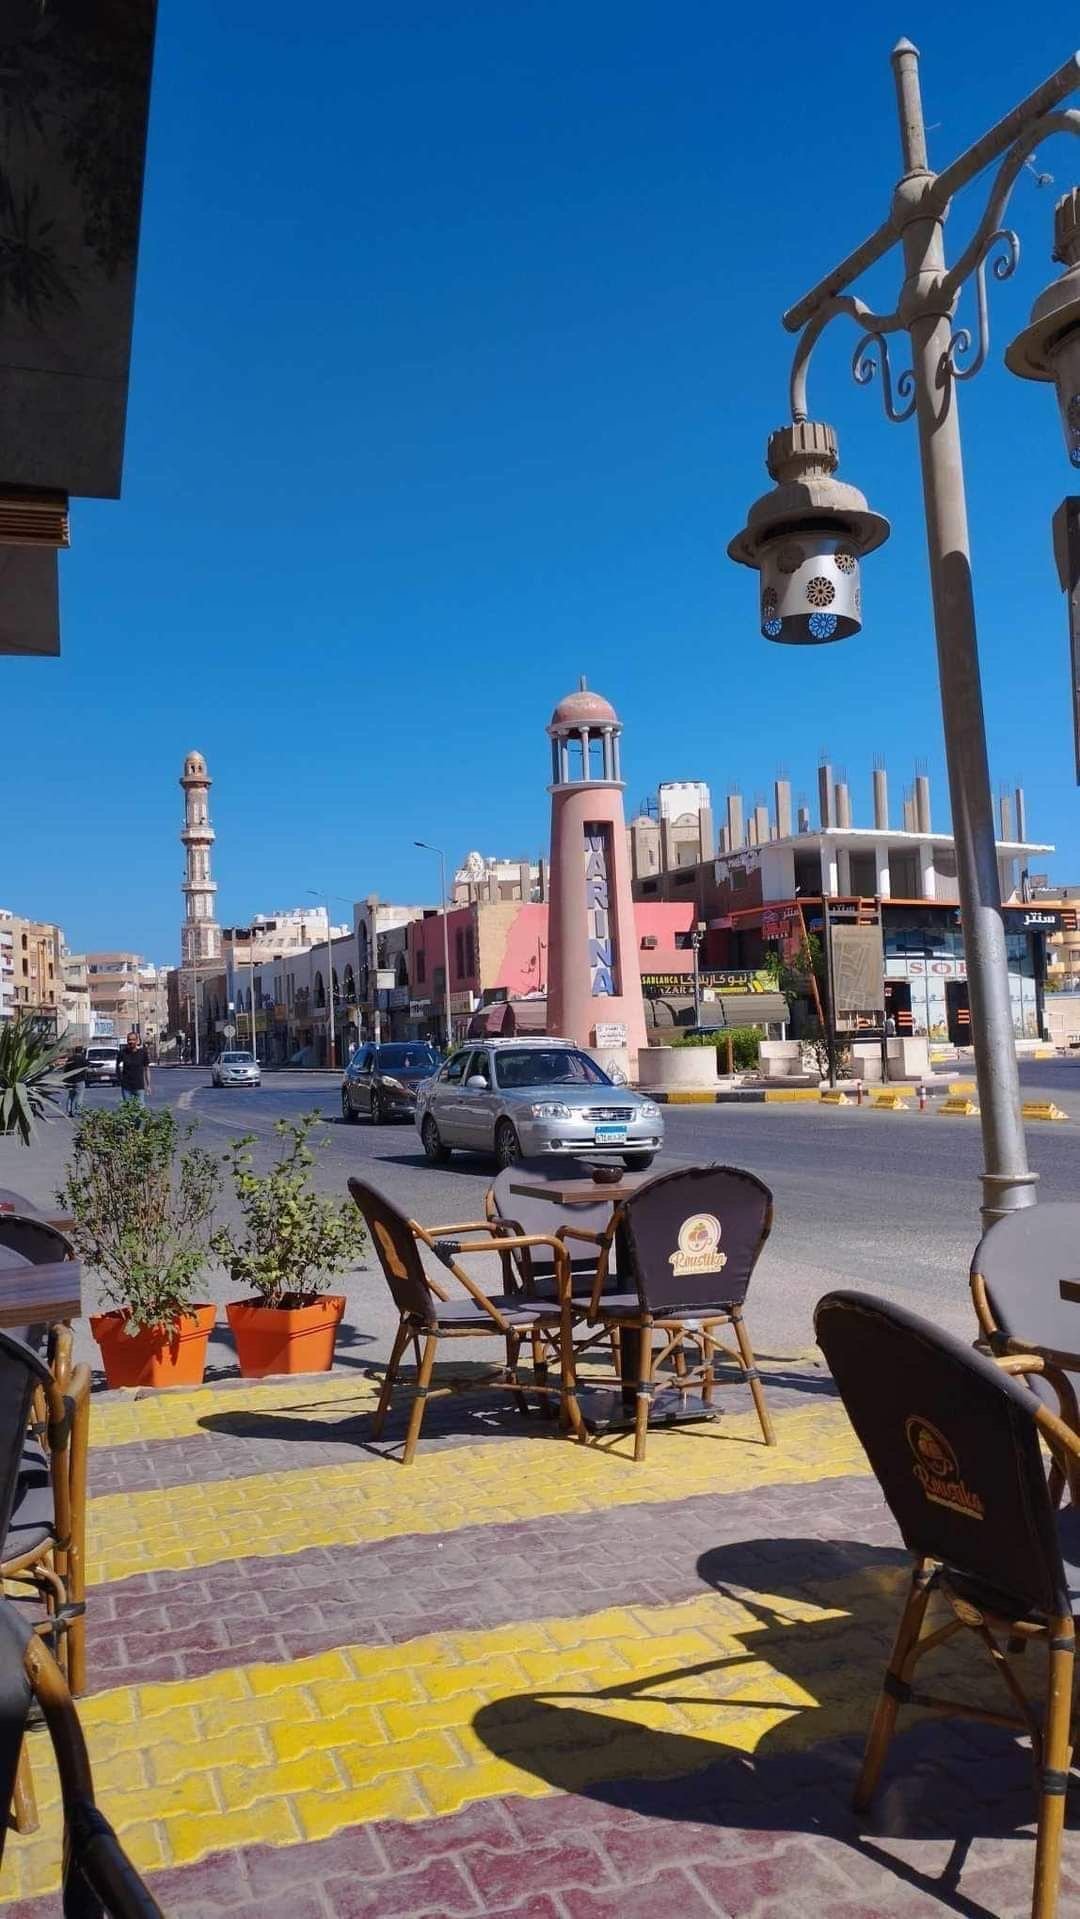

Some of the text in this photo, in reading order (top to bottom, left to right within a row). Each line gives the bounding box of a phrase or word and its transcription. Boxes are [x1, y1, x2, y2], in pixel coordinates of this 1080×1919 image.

[584, 835, 615, 997] MARINA
[1023, 911, 1056, 926] سنتر
[640, 975, 679, 985] SABLANCA
[680, 972, 748, 988] نيو كازبلاكا
